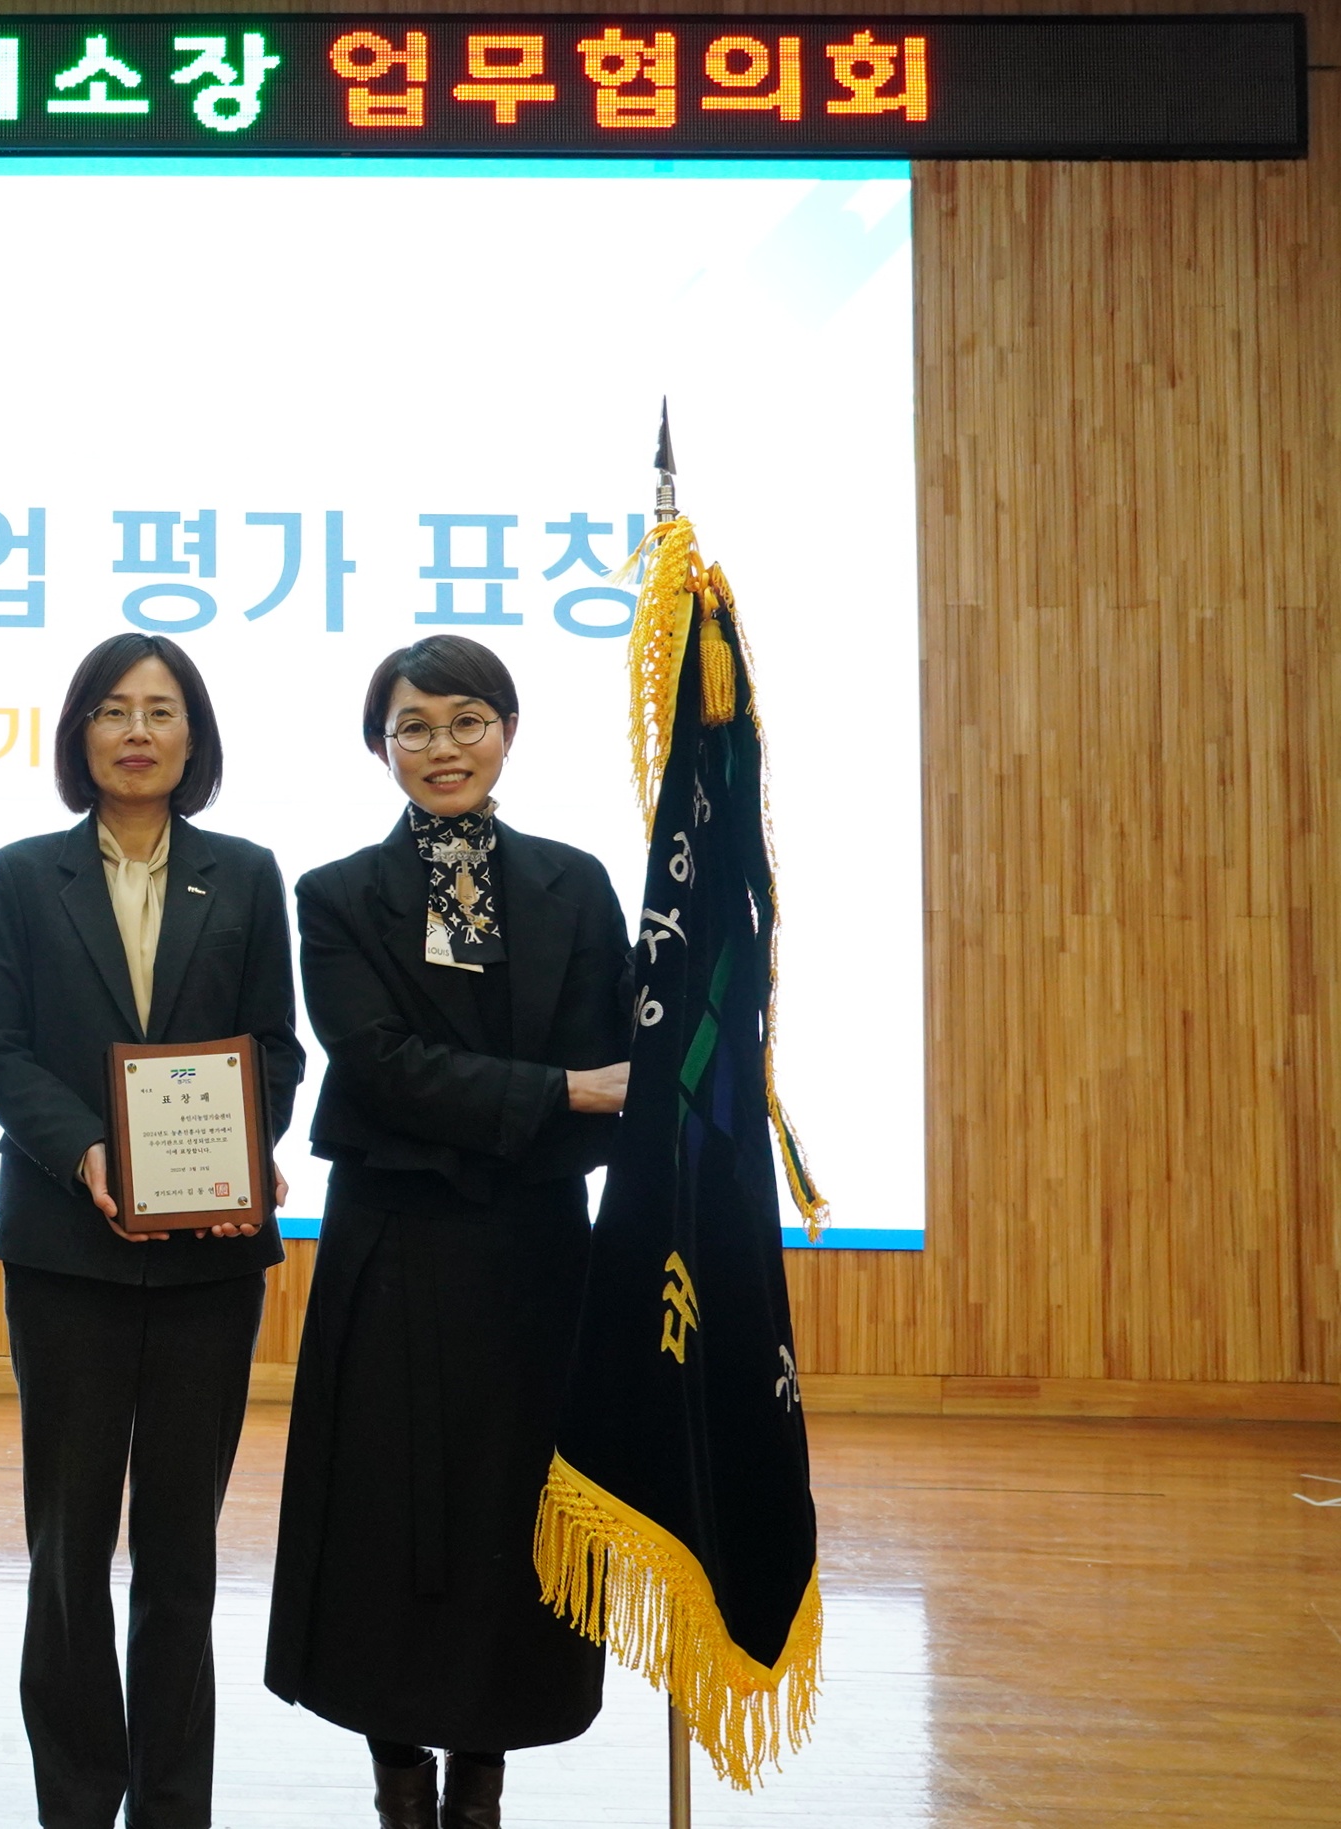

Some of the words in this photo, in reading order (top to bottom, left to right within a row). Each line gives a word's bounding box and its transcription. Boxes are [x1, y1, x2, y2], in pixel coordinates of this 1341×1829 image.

[328, 27, 929, 129] 업무협의회
[113, 508, 356, 634] 평가
[414, 512, 652, 638] 표창
[427, 947, 450, 957] LOUIS
